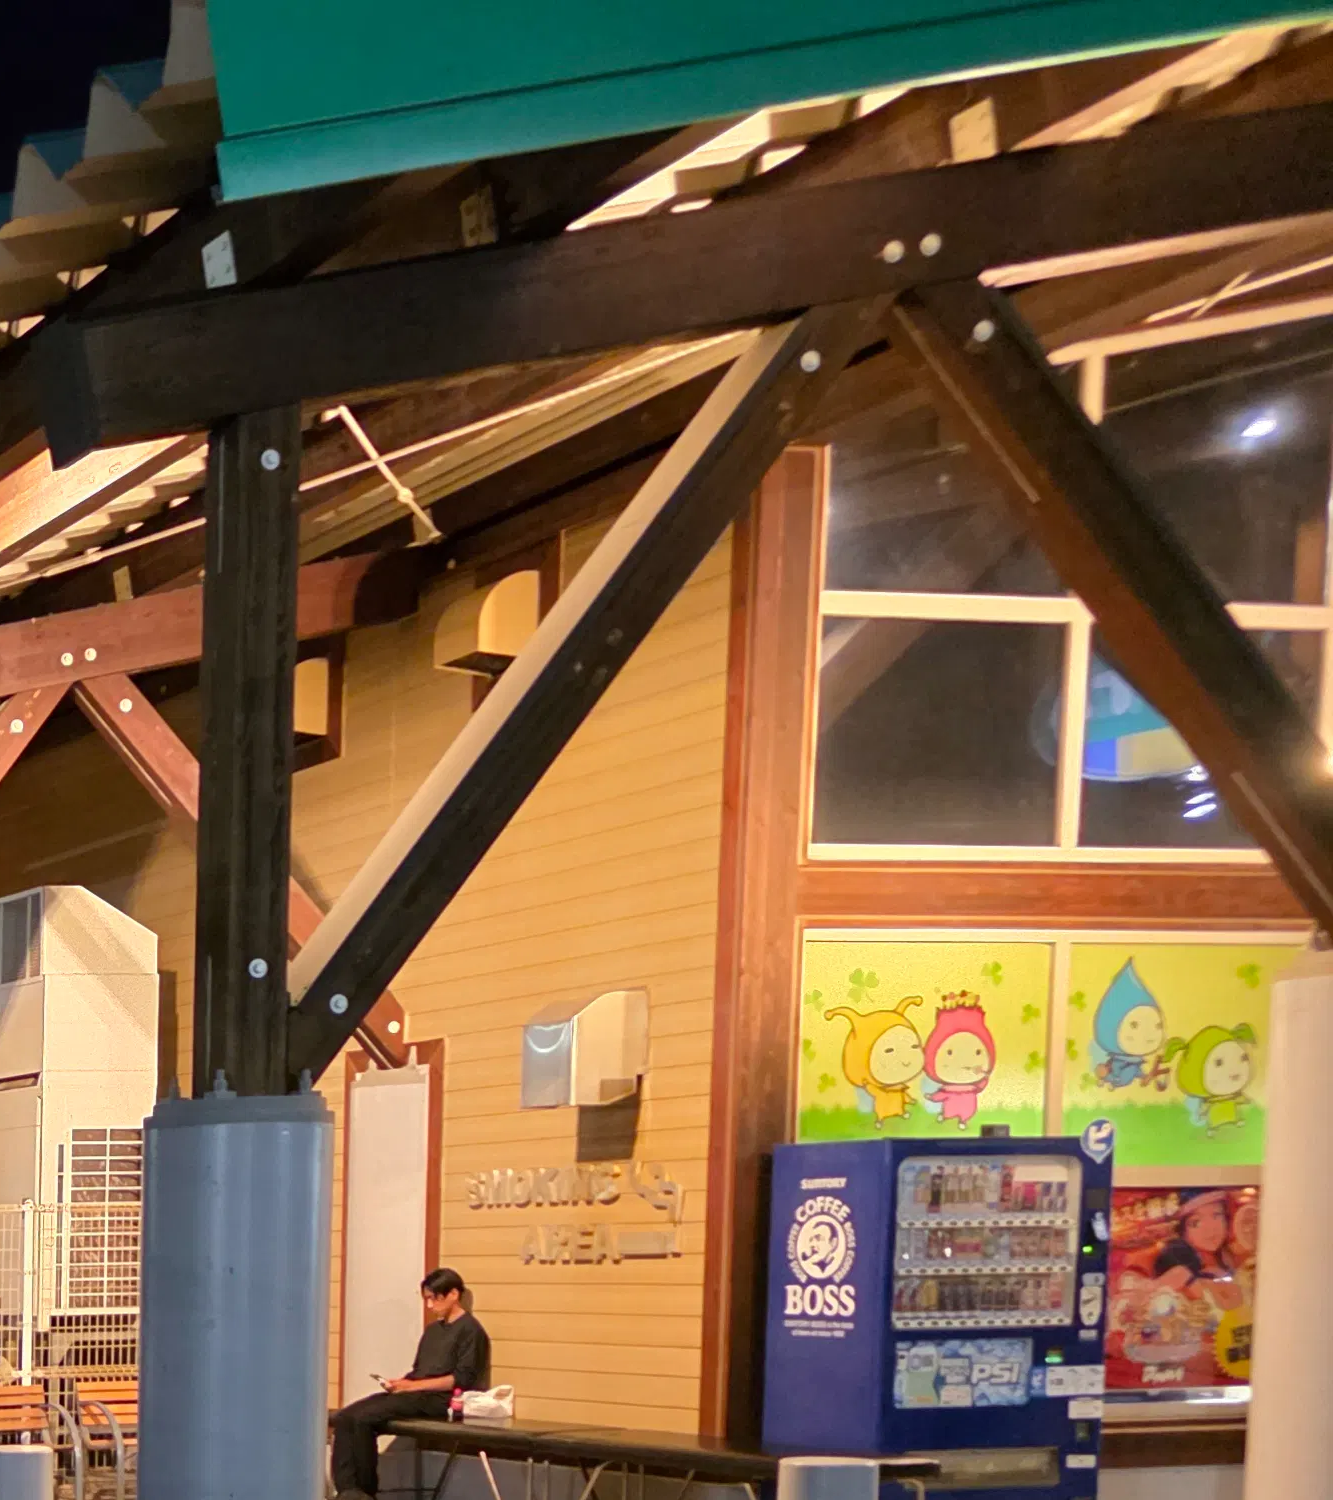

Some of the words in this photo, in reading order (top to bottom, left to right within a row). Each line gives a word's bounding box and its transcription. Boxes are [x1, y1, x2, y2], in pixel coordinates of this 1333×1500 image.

[465, 1164, 621, 1209] SMOKING
[795, 1196, 852, 1222] COFFEE
[520, 1224, 622, 1266] AREA
[783, 1284, 857, 1318] BOSS
